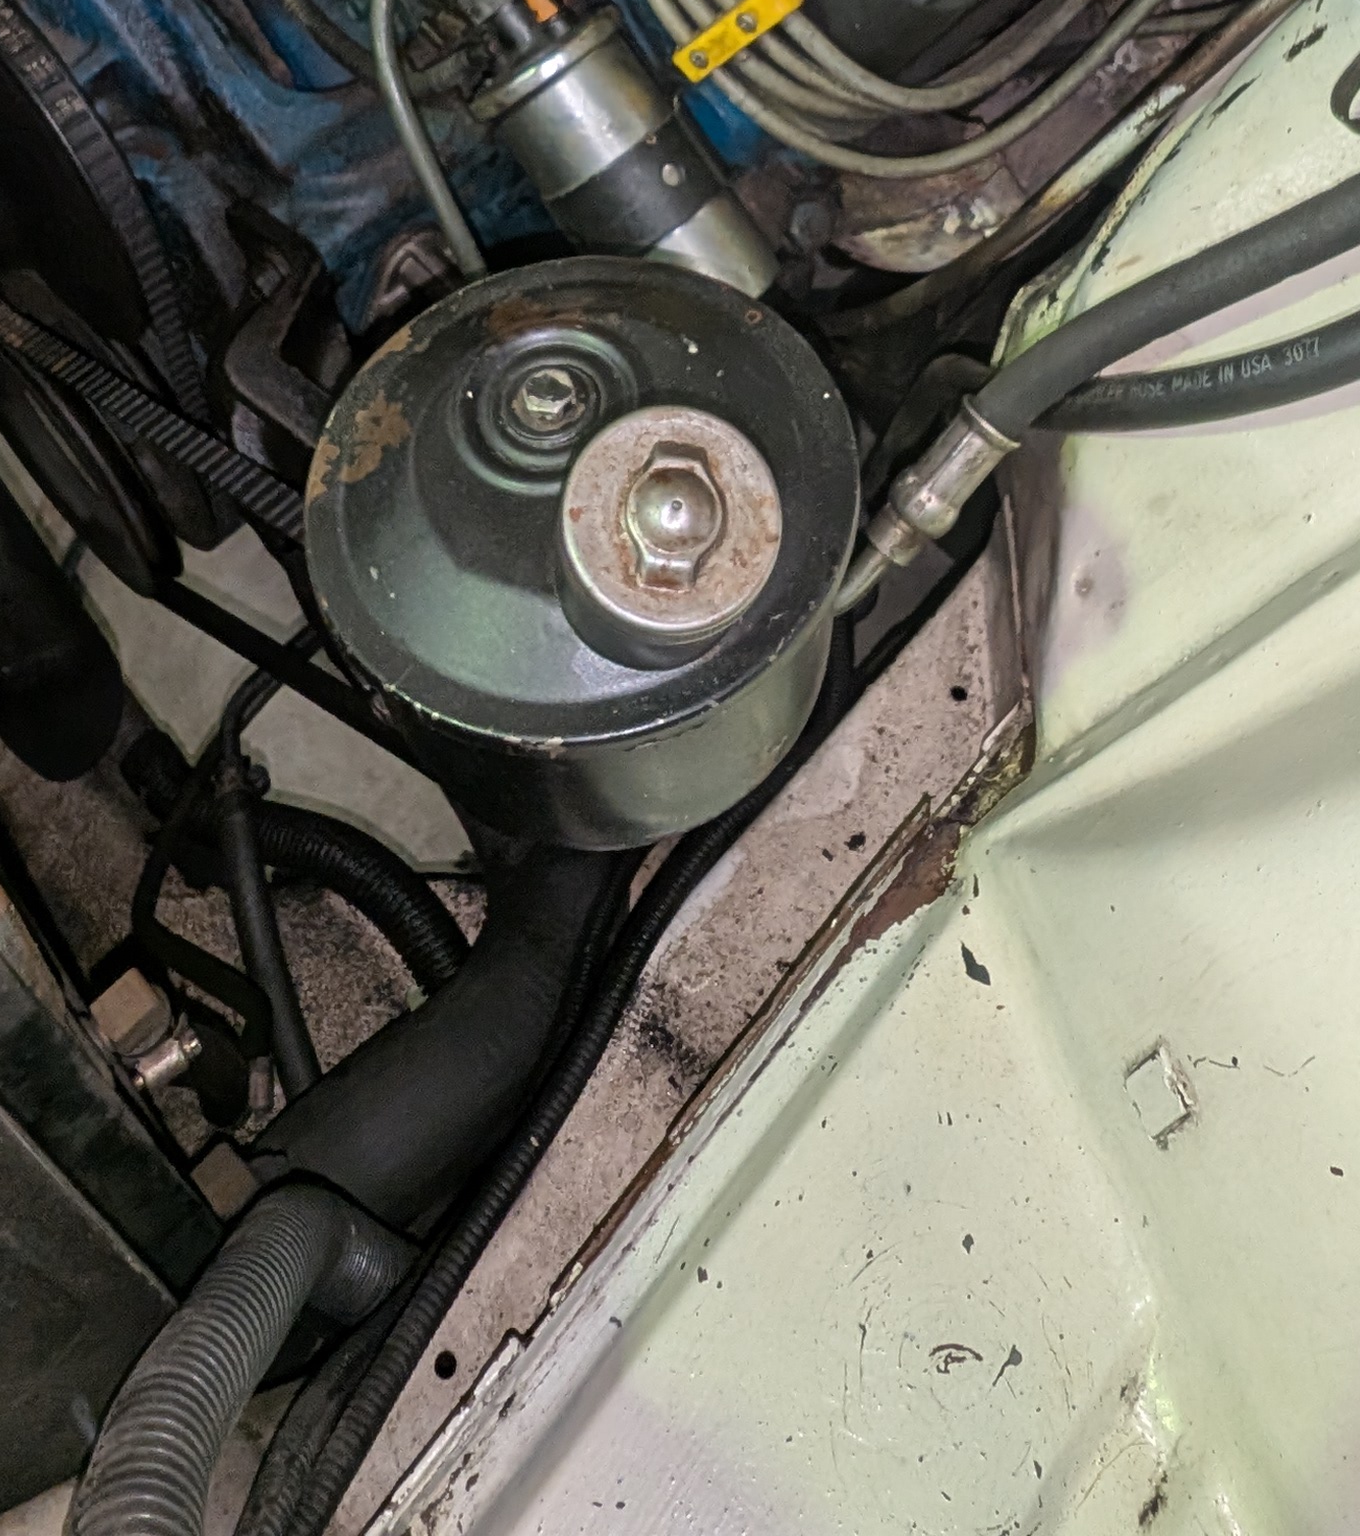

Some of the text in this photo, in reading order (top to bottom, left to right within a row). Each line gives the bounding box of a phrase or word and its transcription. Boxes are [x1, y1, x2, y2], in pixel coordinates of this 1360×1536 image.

[1171, 370, 1213, 392] MADE
[1218, 363, 1235, 382] IN
[1241, 353, 1273, 378] USA
